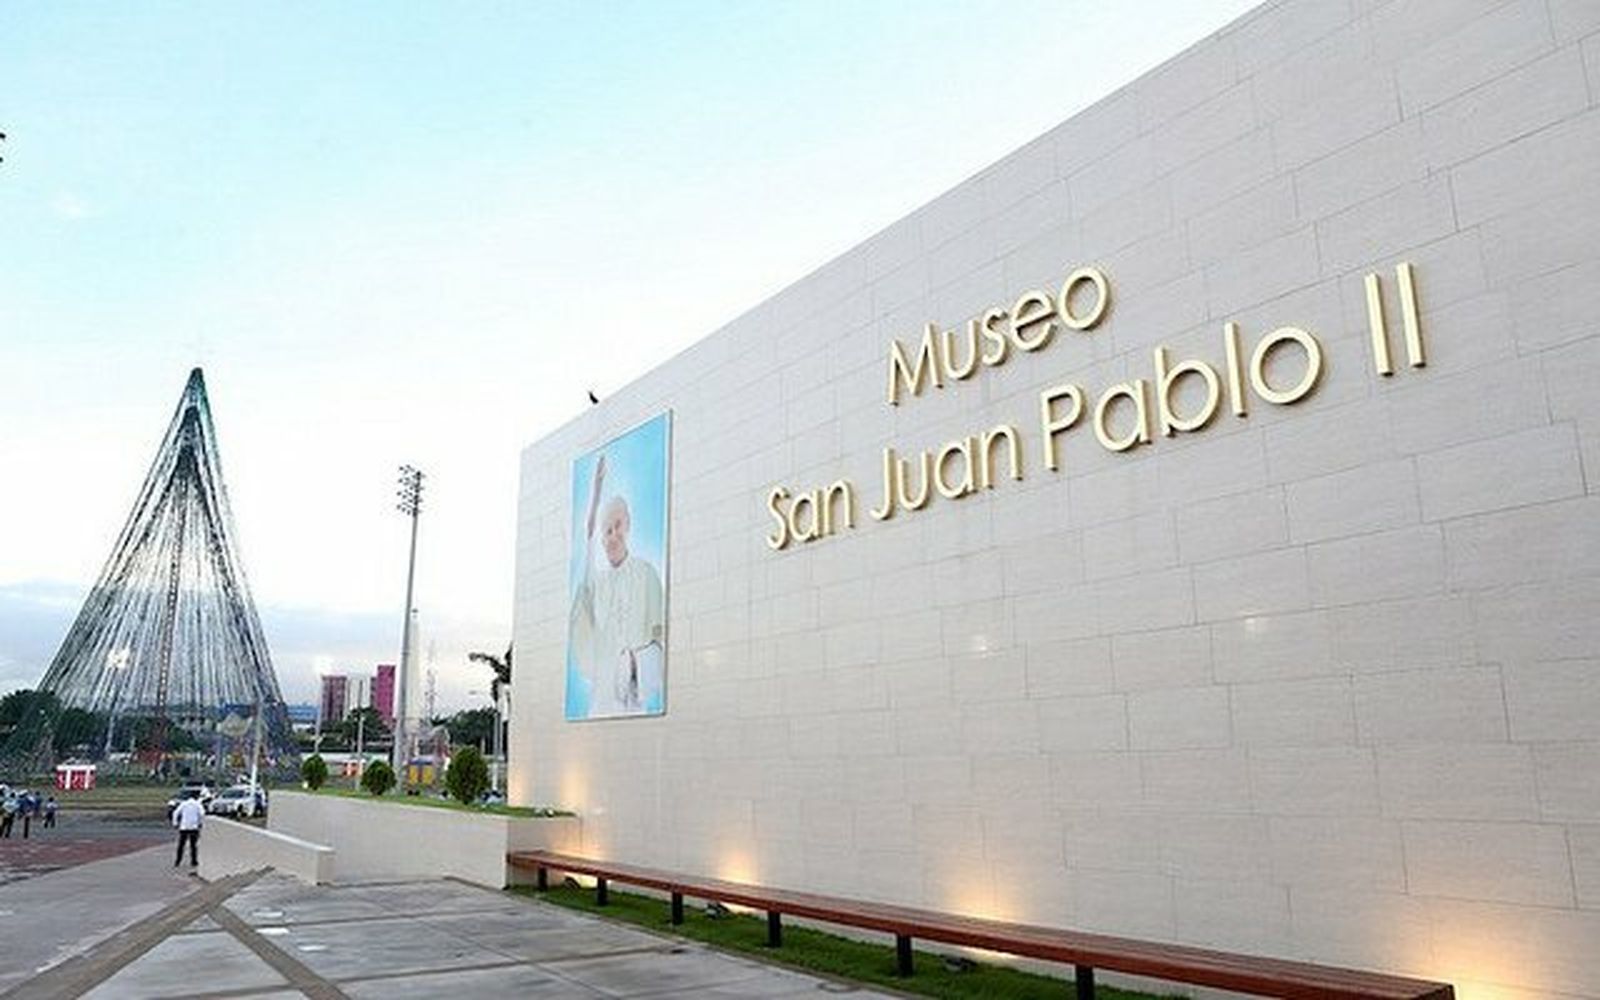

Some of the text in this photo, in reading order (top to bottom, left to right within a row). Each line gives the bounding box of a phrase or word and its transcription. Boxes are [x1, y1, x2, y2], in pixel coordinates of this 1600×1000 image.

[766, 262, 1427, 550] San Juan Pablo II
[886, 266, 1111, 405] Museo
